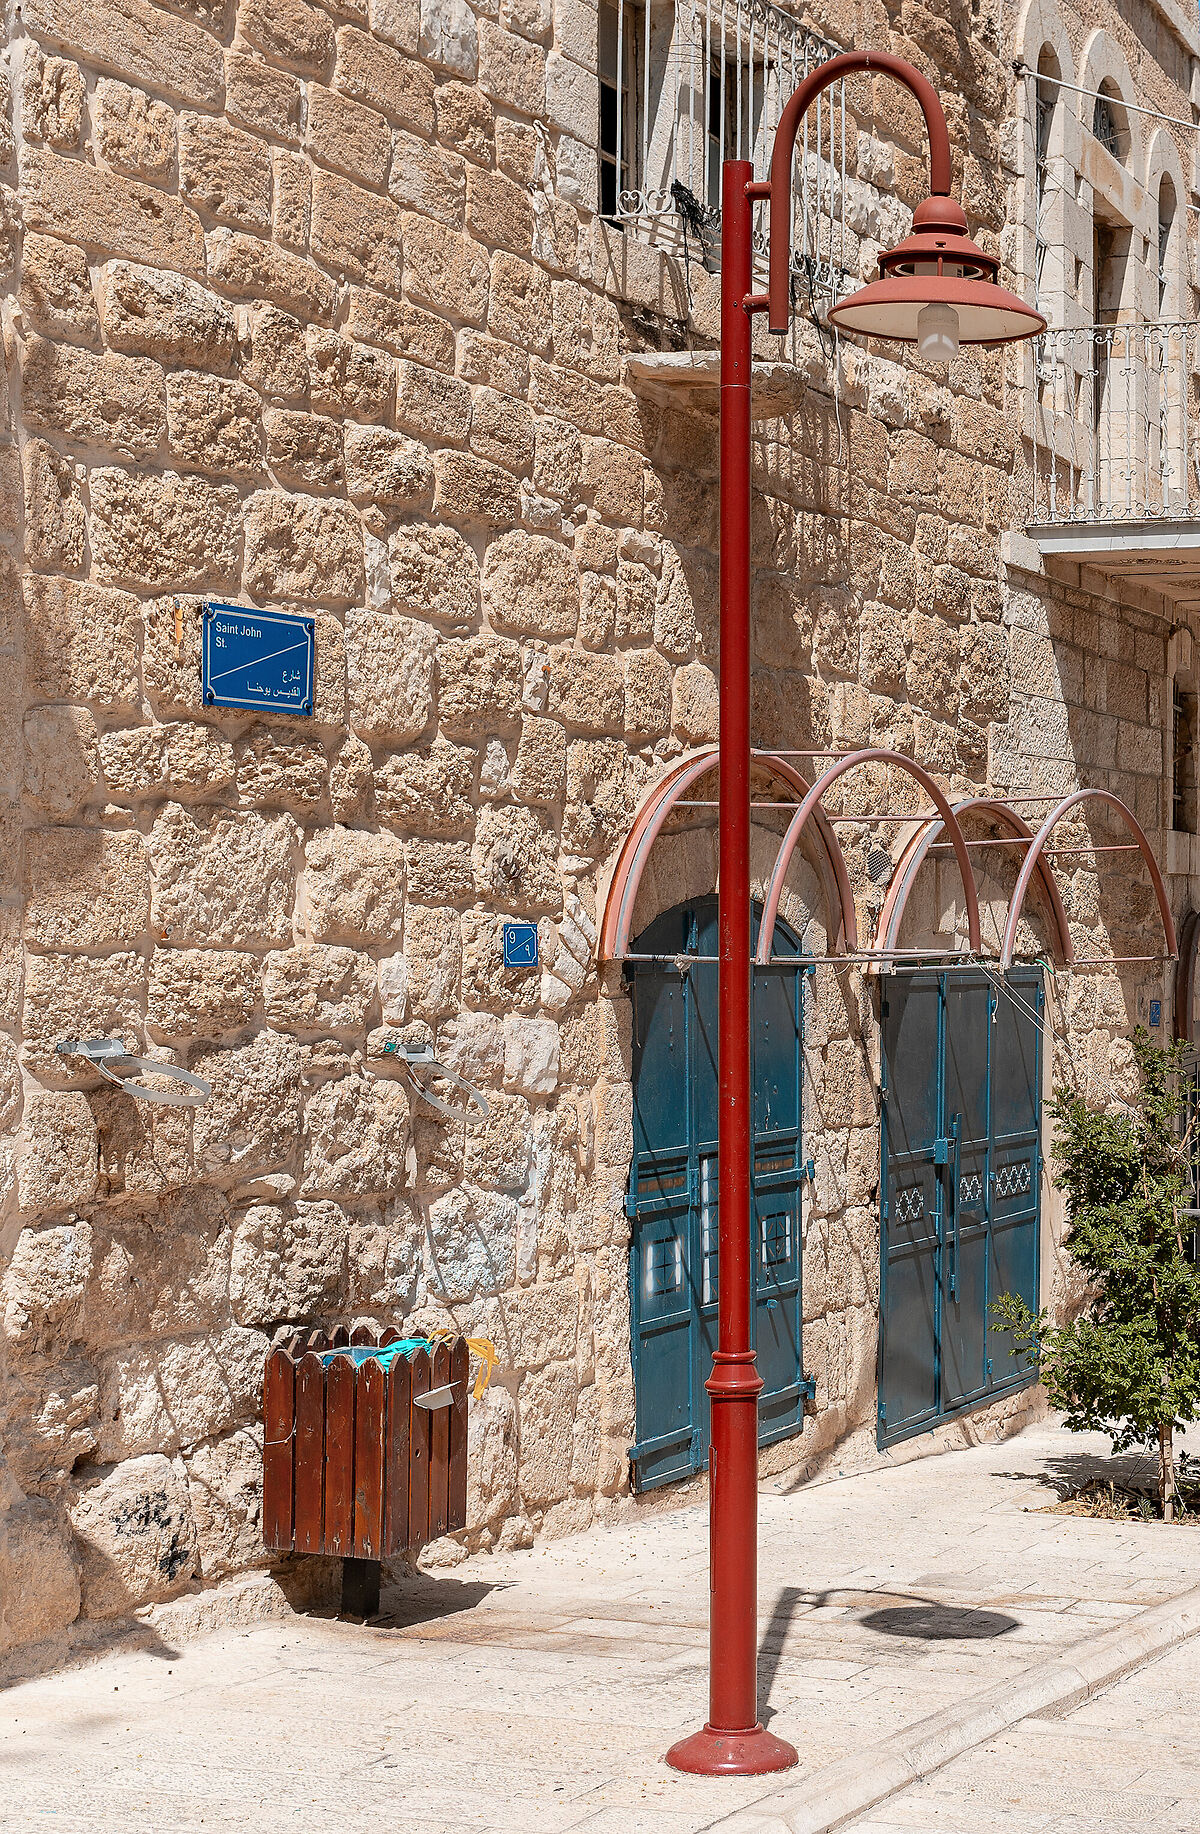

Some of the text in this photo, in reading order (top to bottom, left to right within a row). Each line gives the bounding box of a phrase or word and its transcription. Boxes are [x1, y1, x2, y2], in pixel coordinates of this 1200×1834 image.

[215, 621, 262, 638] Saint John
[215, 636, 228, 648] St.
[282, 669, 301, 684] شارع
[509, 931, 516, 944] 9
